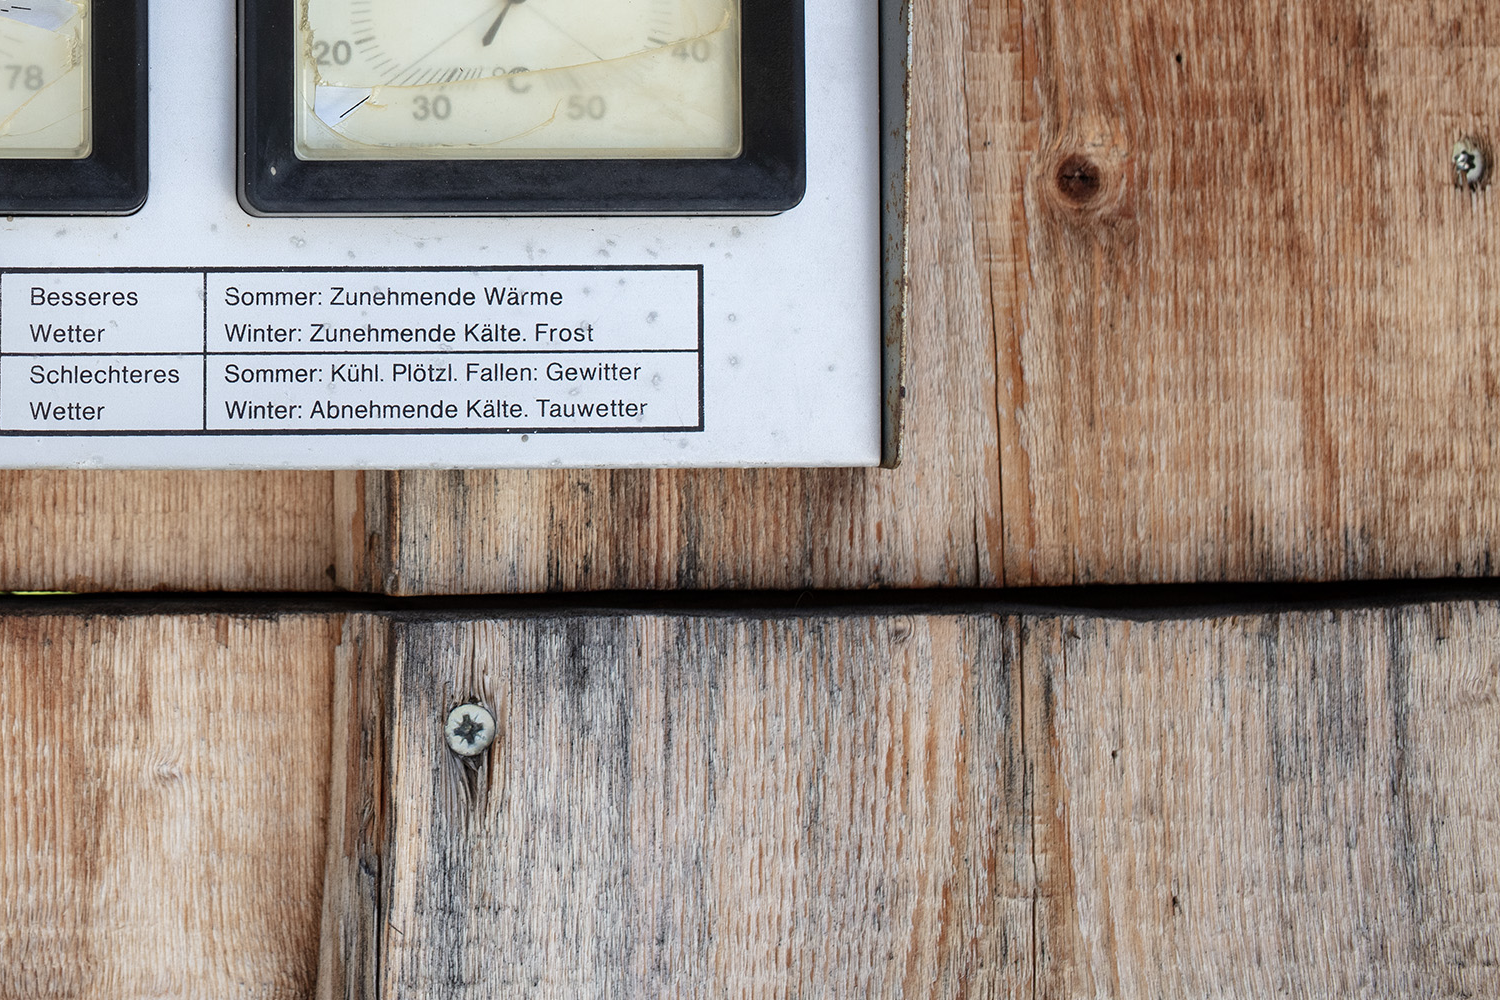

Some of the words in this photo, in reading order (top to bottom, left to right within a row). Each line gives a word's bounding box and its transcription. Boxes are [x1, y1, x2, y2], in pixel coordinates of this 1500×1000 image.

[315, 40, 352, 66] 20
[671, 40, 710, 64] 40
[5, 65, 45, 91] 78
[412, 96, 452, 121] 30
[567, 96, 607, 121] 50
[30, 286, 139, 307] Besseres
[224, 286, 322, 307] Sommer:
[329, 286, 476, 307] Zunehmende
[483, 286, 563, 306] Wärme
[29, 323, 106, 344] Wetter
[224, 323, 302, 343] Winter:
[309, 323, 456, 343] Zunehmende
[464, 323, 527, 343] Kälte.
[535, 322, 594, 343] Frost
[29, 364, 180, 385] Schlechteres
[224, 363, 323, 384] Sommer:
[331, 363, 384, 383] Kühl.
[392, 363, 458, 383] Plötzl.
[466, 362, 538, 382] Fallen:
[546, 361, 642, 382] Gewitter
[29, 401, 106, 421] Wetter
[224, 400, 302, 420] Winter:
[309, 399, 459, 420] Abnehmende
[466, 399, 528, 419] Kälte.
[535, 398, 649, 418] Tauwetter
